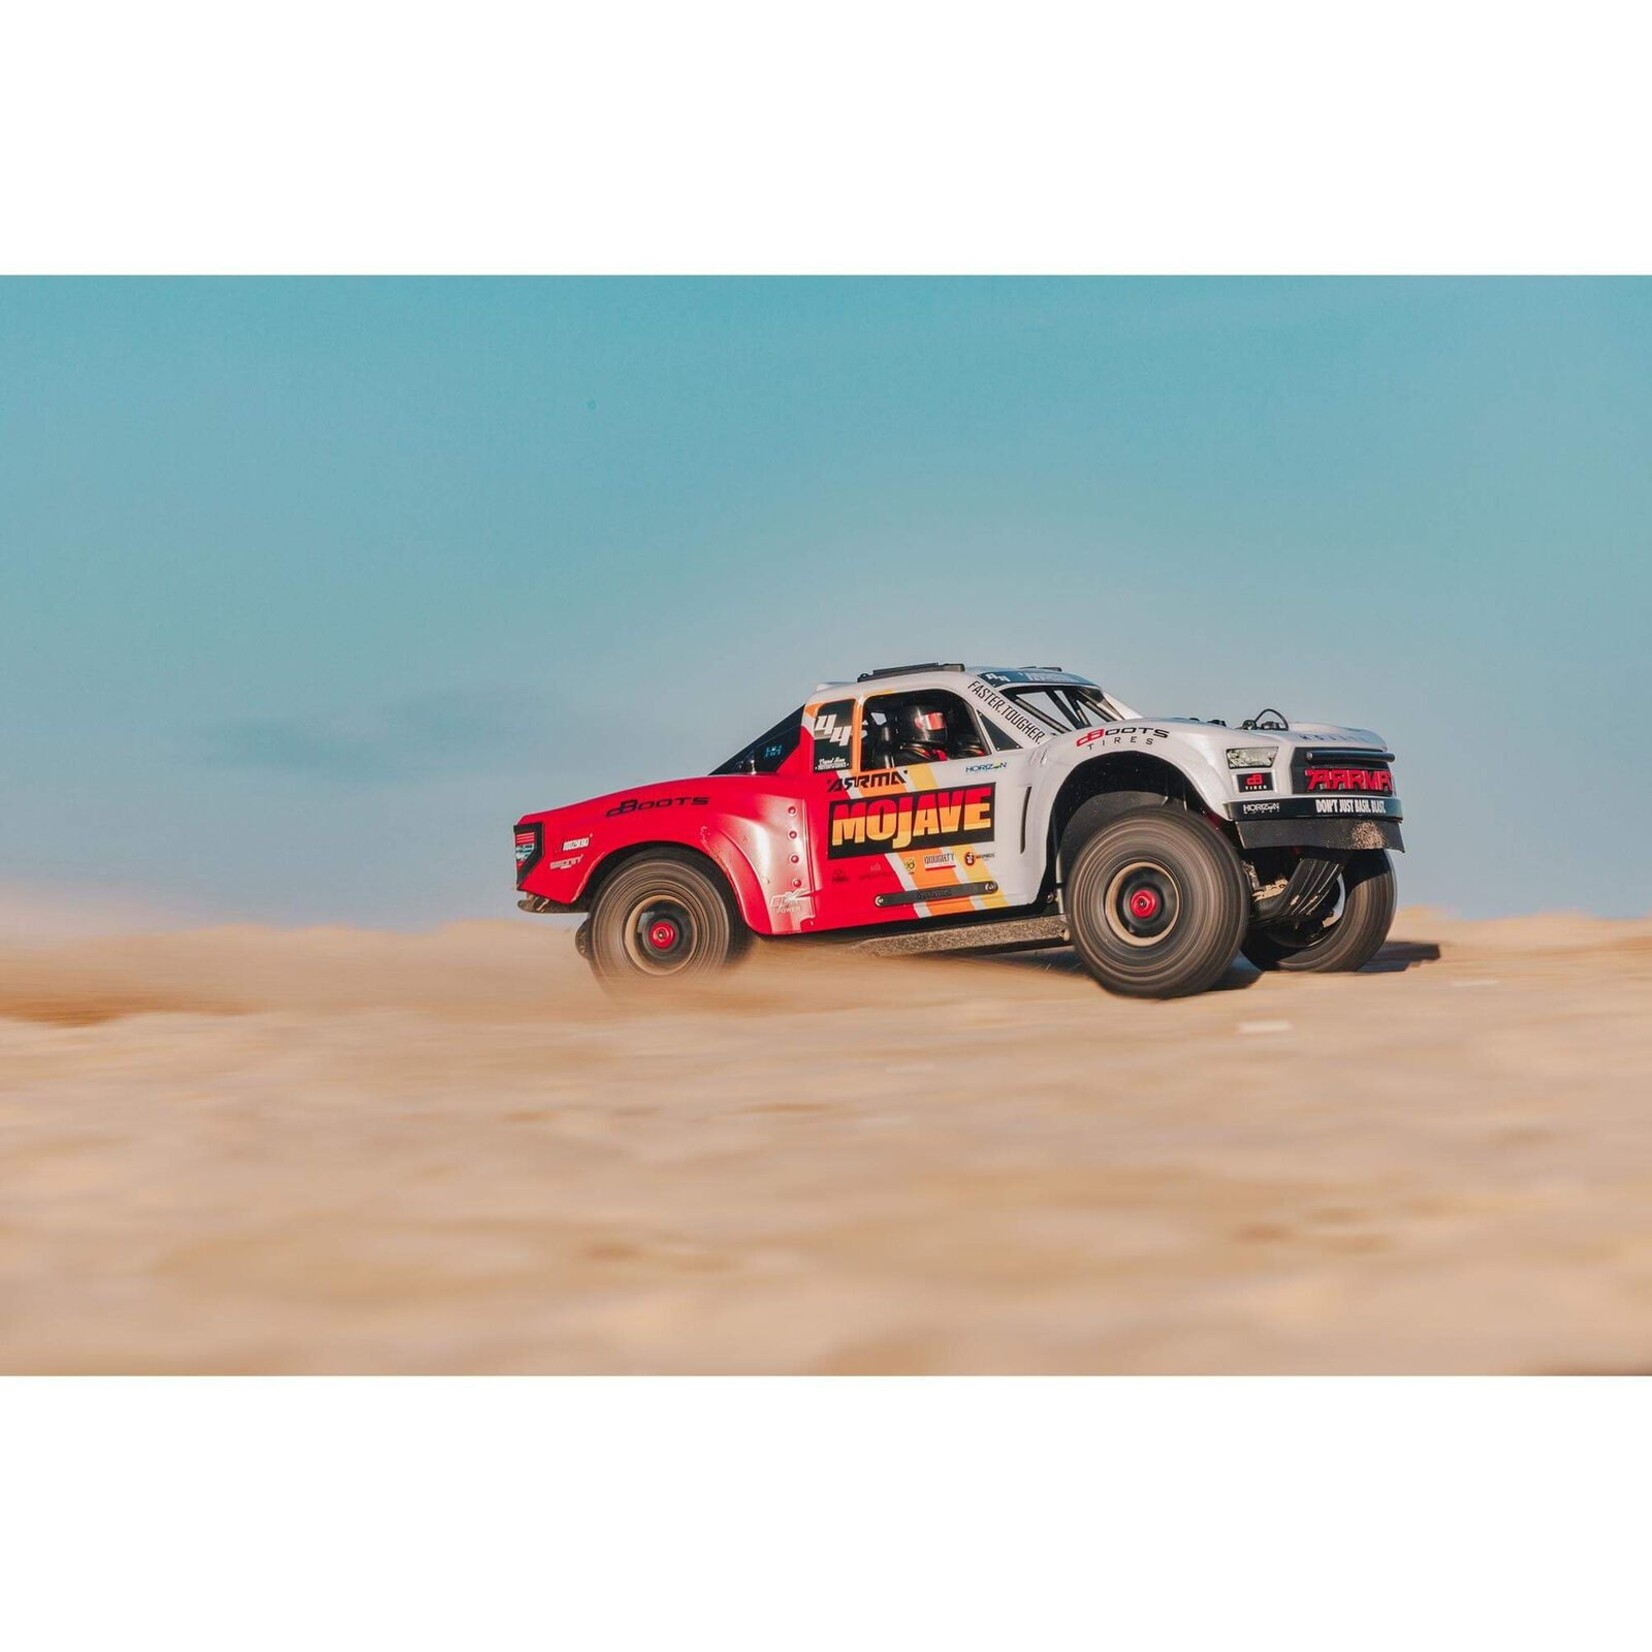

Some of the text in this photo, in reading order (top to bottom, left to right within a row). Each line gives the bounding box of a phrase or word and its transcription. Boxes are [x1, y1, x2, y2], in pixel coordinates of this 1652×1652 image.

[815, 714, 852, 747] 44
[967, 681, 1046, 745] FASTER. TOUGHER.
[1087, 736, 1154, 751] TIRES
[832, 787, 992, 849] MOJAVE
